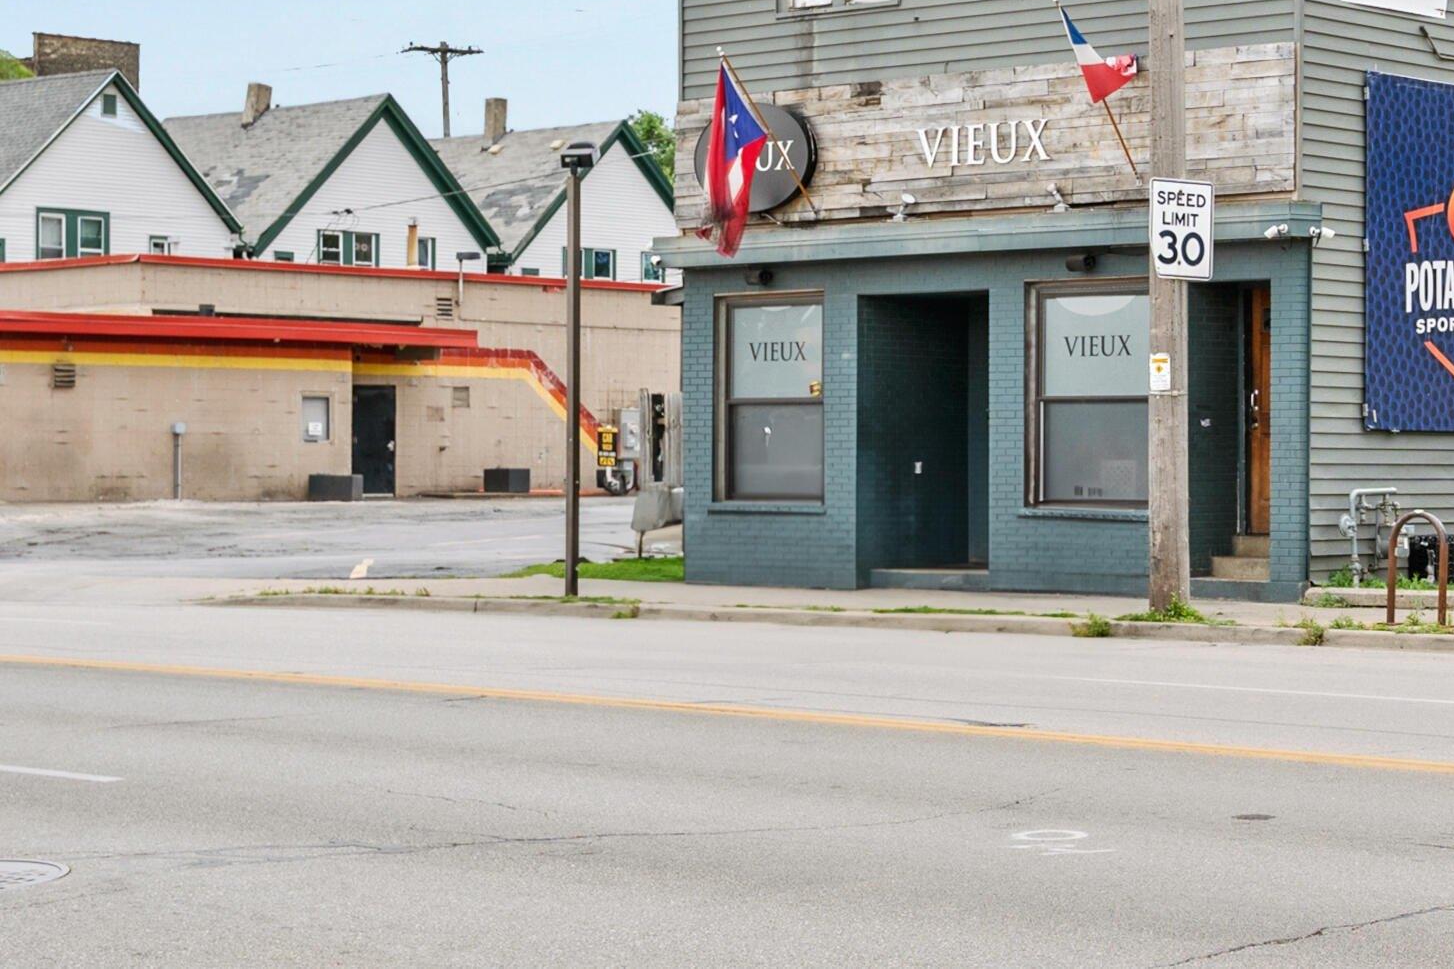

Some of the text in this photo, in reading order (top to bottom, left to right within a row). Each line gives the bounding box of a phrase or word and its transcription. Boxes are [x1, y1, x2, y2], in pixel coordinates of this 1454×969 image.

[917, 118, 1052, 169] VIEUX
[1157, 190, 1207, 208] SPEED
[1162, 211, 1199, 227] LIMIT
[1157, 229, 1205, 266] 30
[748, 340, 807, 362] VIEUX
[1063, 334, 1132, 357] VIEUX
